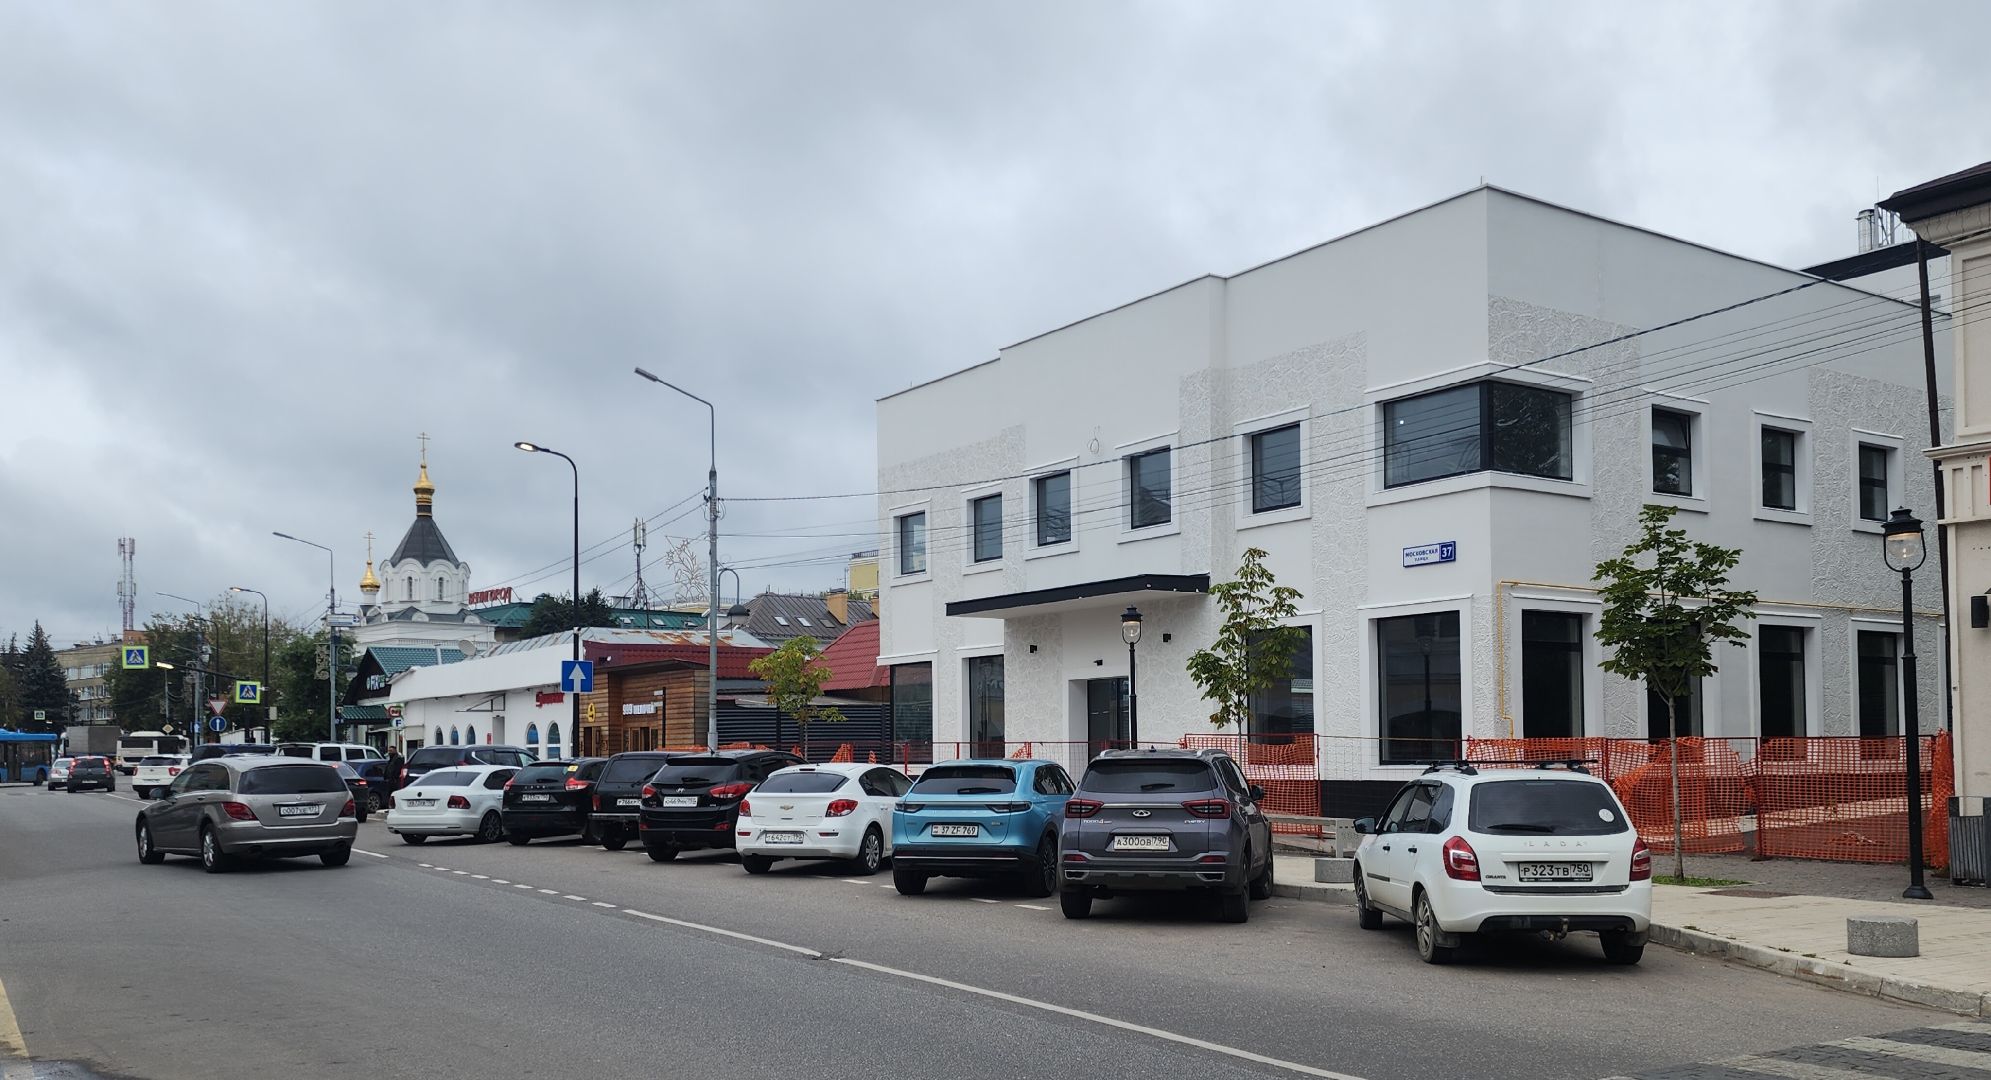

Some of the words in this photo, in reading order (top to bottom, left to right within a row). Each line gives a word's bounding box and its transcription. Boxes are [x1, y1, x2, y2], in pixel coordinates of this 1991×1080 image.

[1441, 547, 1452, 558] 37
[941, 826, 950, 834] 37
[951, 826, 962, 834] ZF
[962, 826, 976, 834] 769
[1116, 836, 1152, 846] А300ОВ
[1152, 836, 1167, 845] 790
[1523, 864, 1570, 876] Р323ТВ
[1571, 863, 1589, 873] 750
